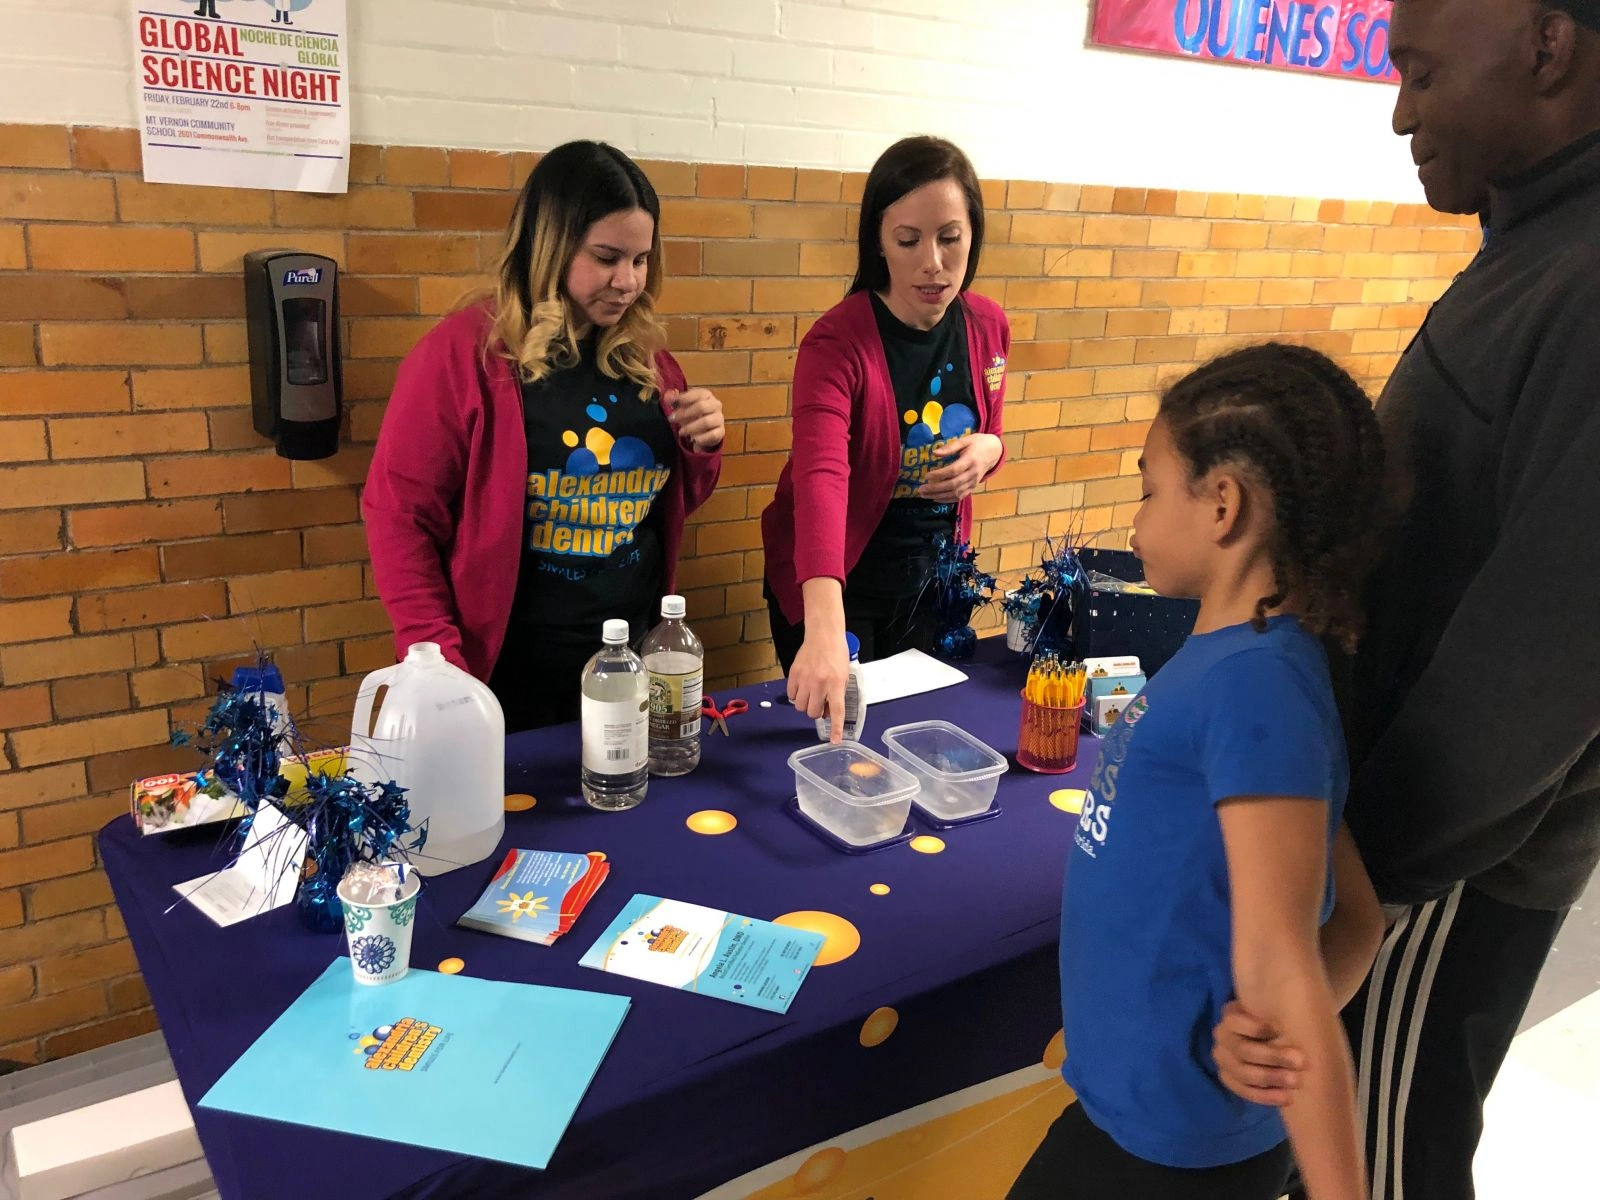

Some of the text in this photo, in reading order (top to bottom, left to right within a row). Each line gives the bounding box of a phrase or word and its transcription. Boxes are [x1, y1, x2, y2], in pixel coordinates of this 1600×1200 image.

[139, 16, 245, 57] GLOBAL
[239, 28, 340, 52] NOCHE DE CIENCIA
[1174, 0, 1393, 77] QUIENES SO
[297, 51, 340, 67] GLOBAL
[142, 55, 341, 103] SCIENCE NIGHT
[172, 95, 209, 108] FEBRUARY
[210, 99, 229, 110] 22nd
[146, 126, 177, 138] SCHOOL
[159, 116, 190, 128] VERNON
[190, 119, 236, 132] COMMUNITY
[287, 272, 319, 283] Purell
[527, 464, 670, 498] alexandria
[144, 775, 177, 788] 100
